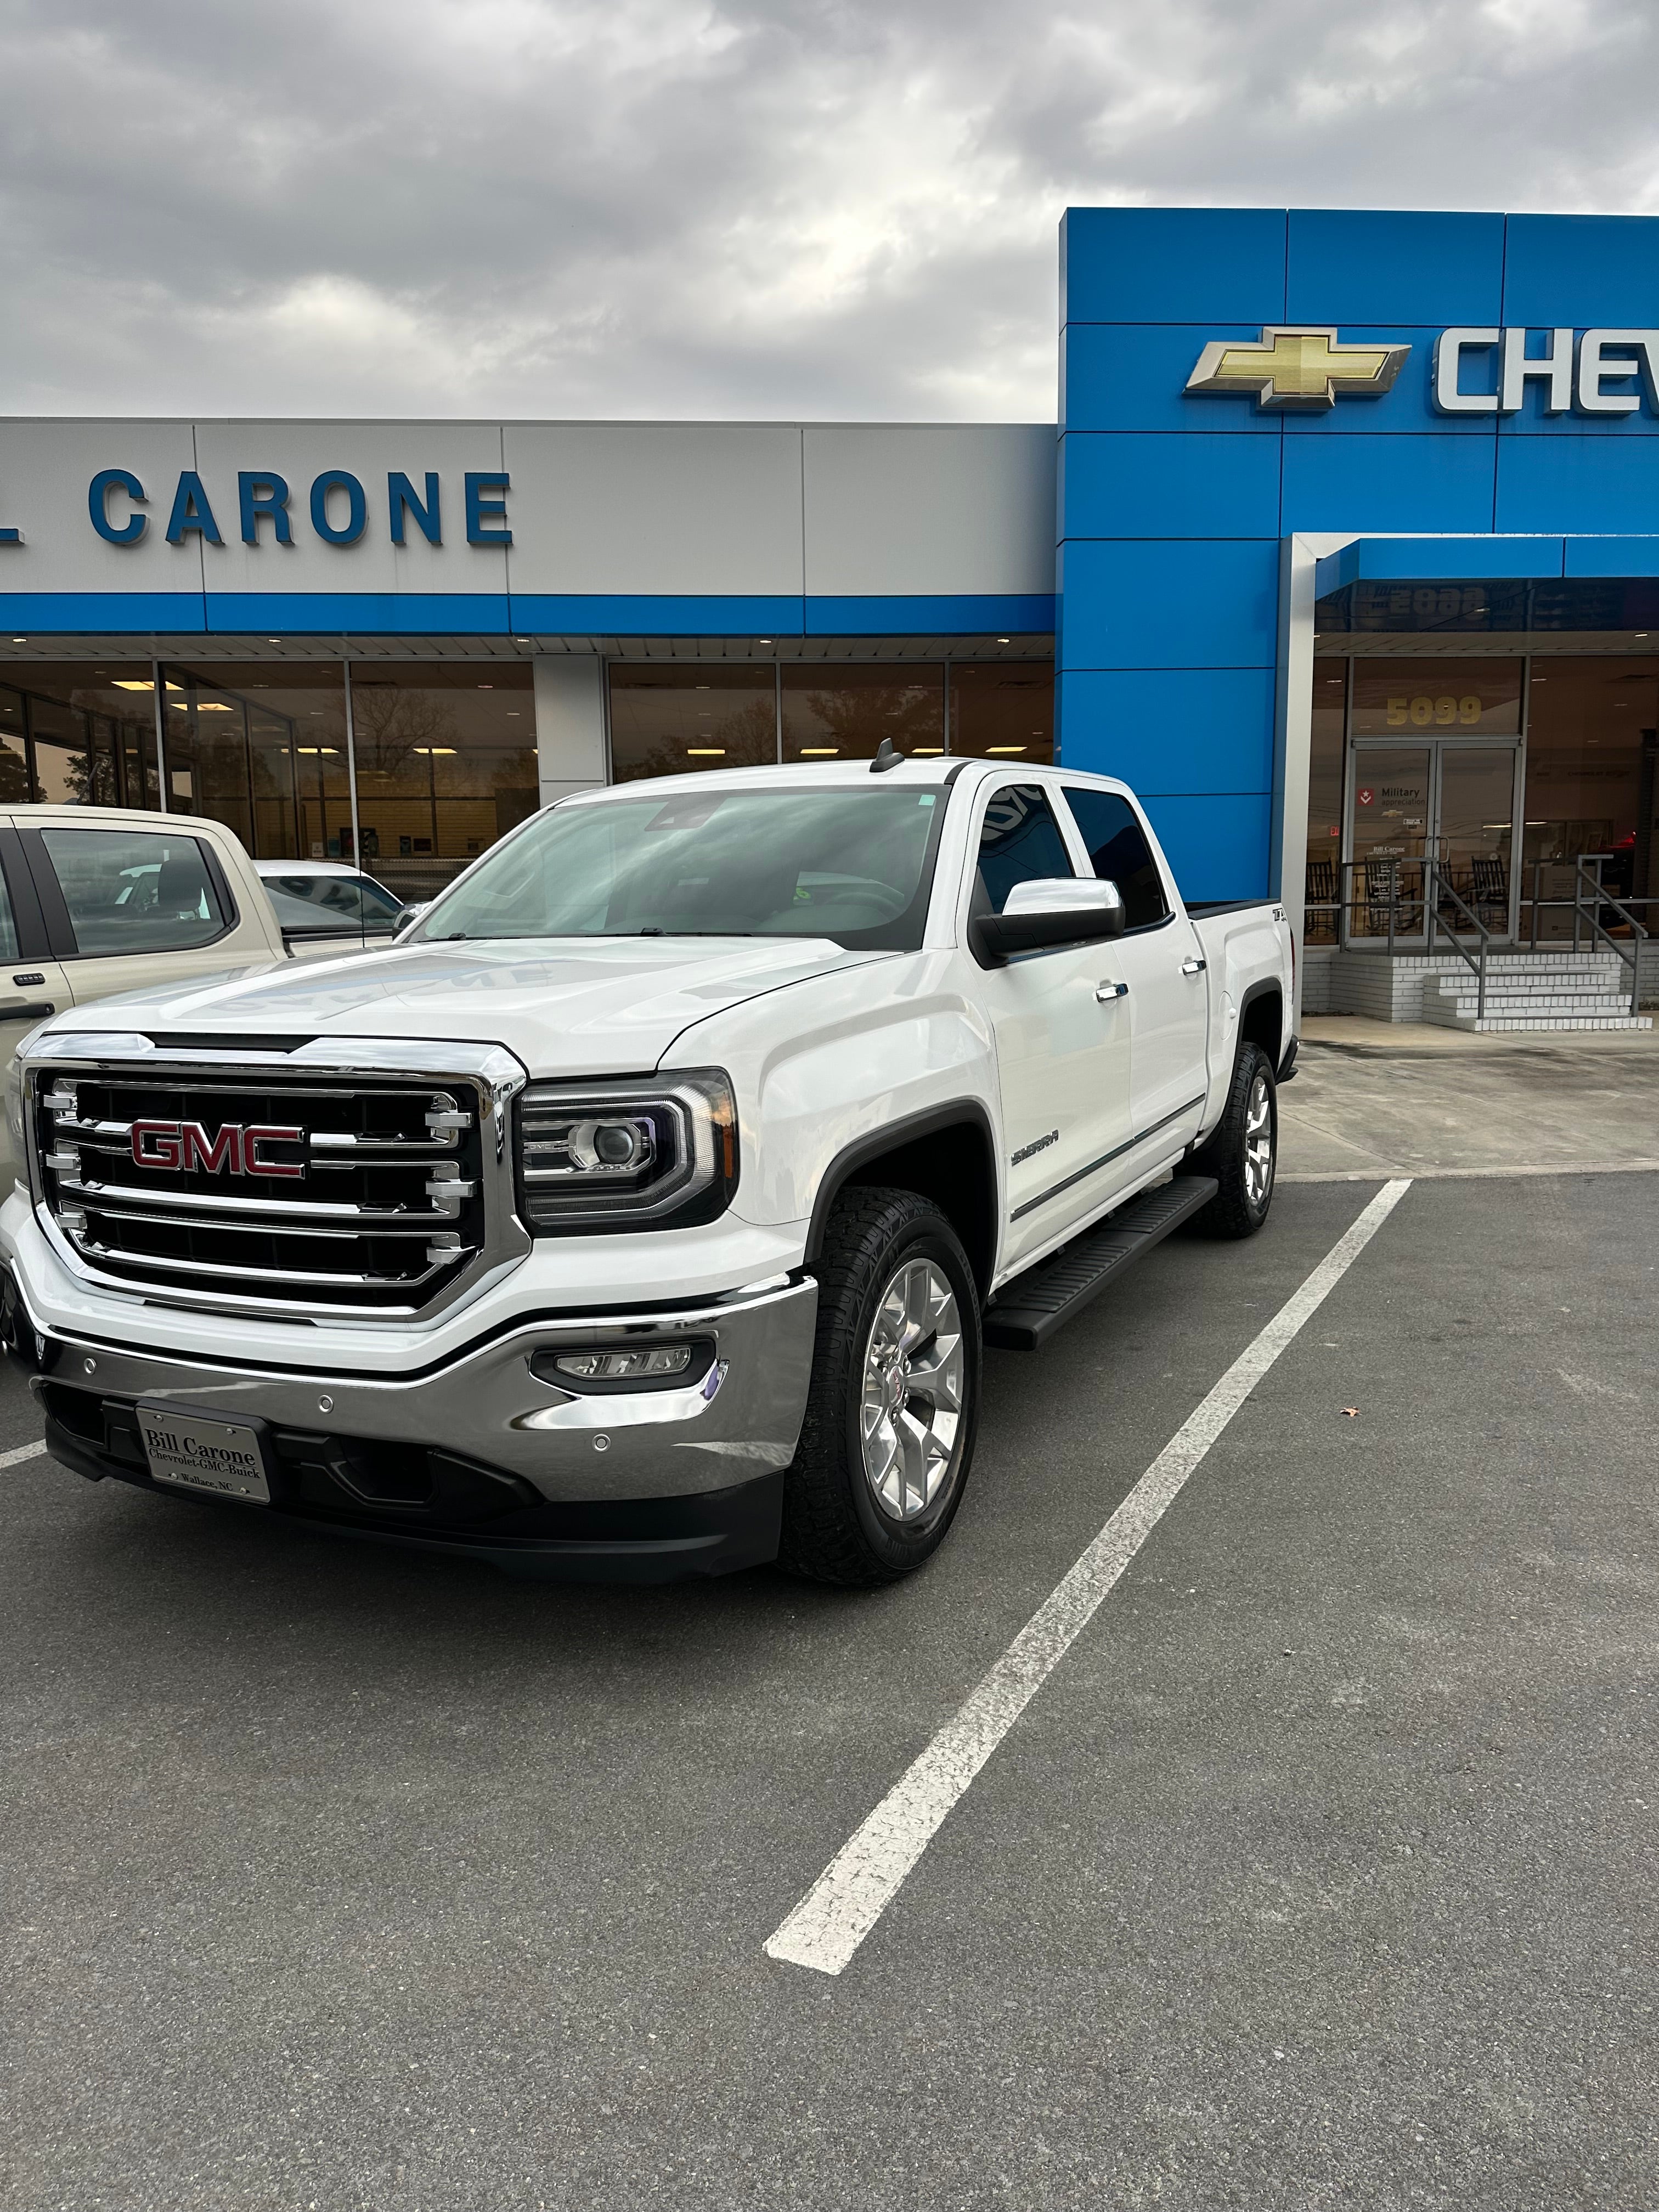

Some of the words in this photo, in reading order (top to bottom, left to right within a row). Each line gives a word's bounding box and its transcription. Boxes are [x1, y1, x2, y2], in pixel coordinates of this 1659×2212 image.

[1432, 328, 1659, 414] CHE
[88, 469, 513, 545] CARONE
[1386, 696, 1482, 725] 5099
[1382, 787, 1420, 798] Military
[131, 1119, 306, 1180] GMC
[145, 1428, 180, 1452] Bill
[183, 1437, 256, 1465] Carone
[149, 1448, 261, 1479] Chevrolet-GMC-Buick
[181, 1473, 218, 1489] Wallace,
[219, 1481, 233, 1491] NC
